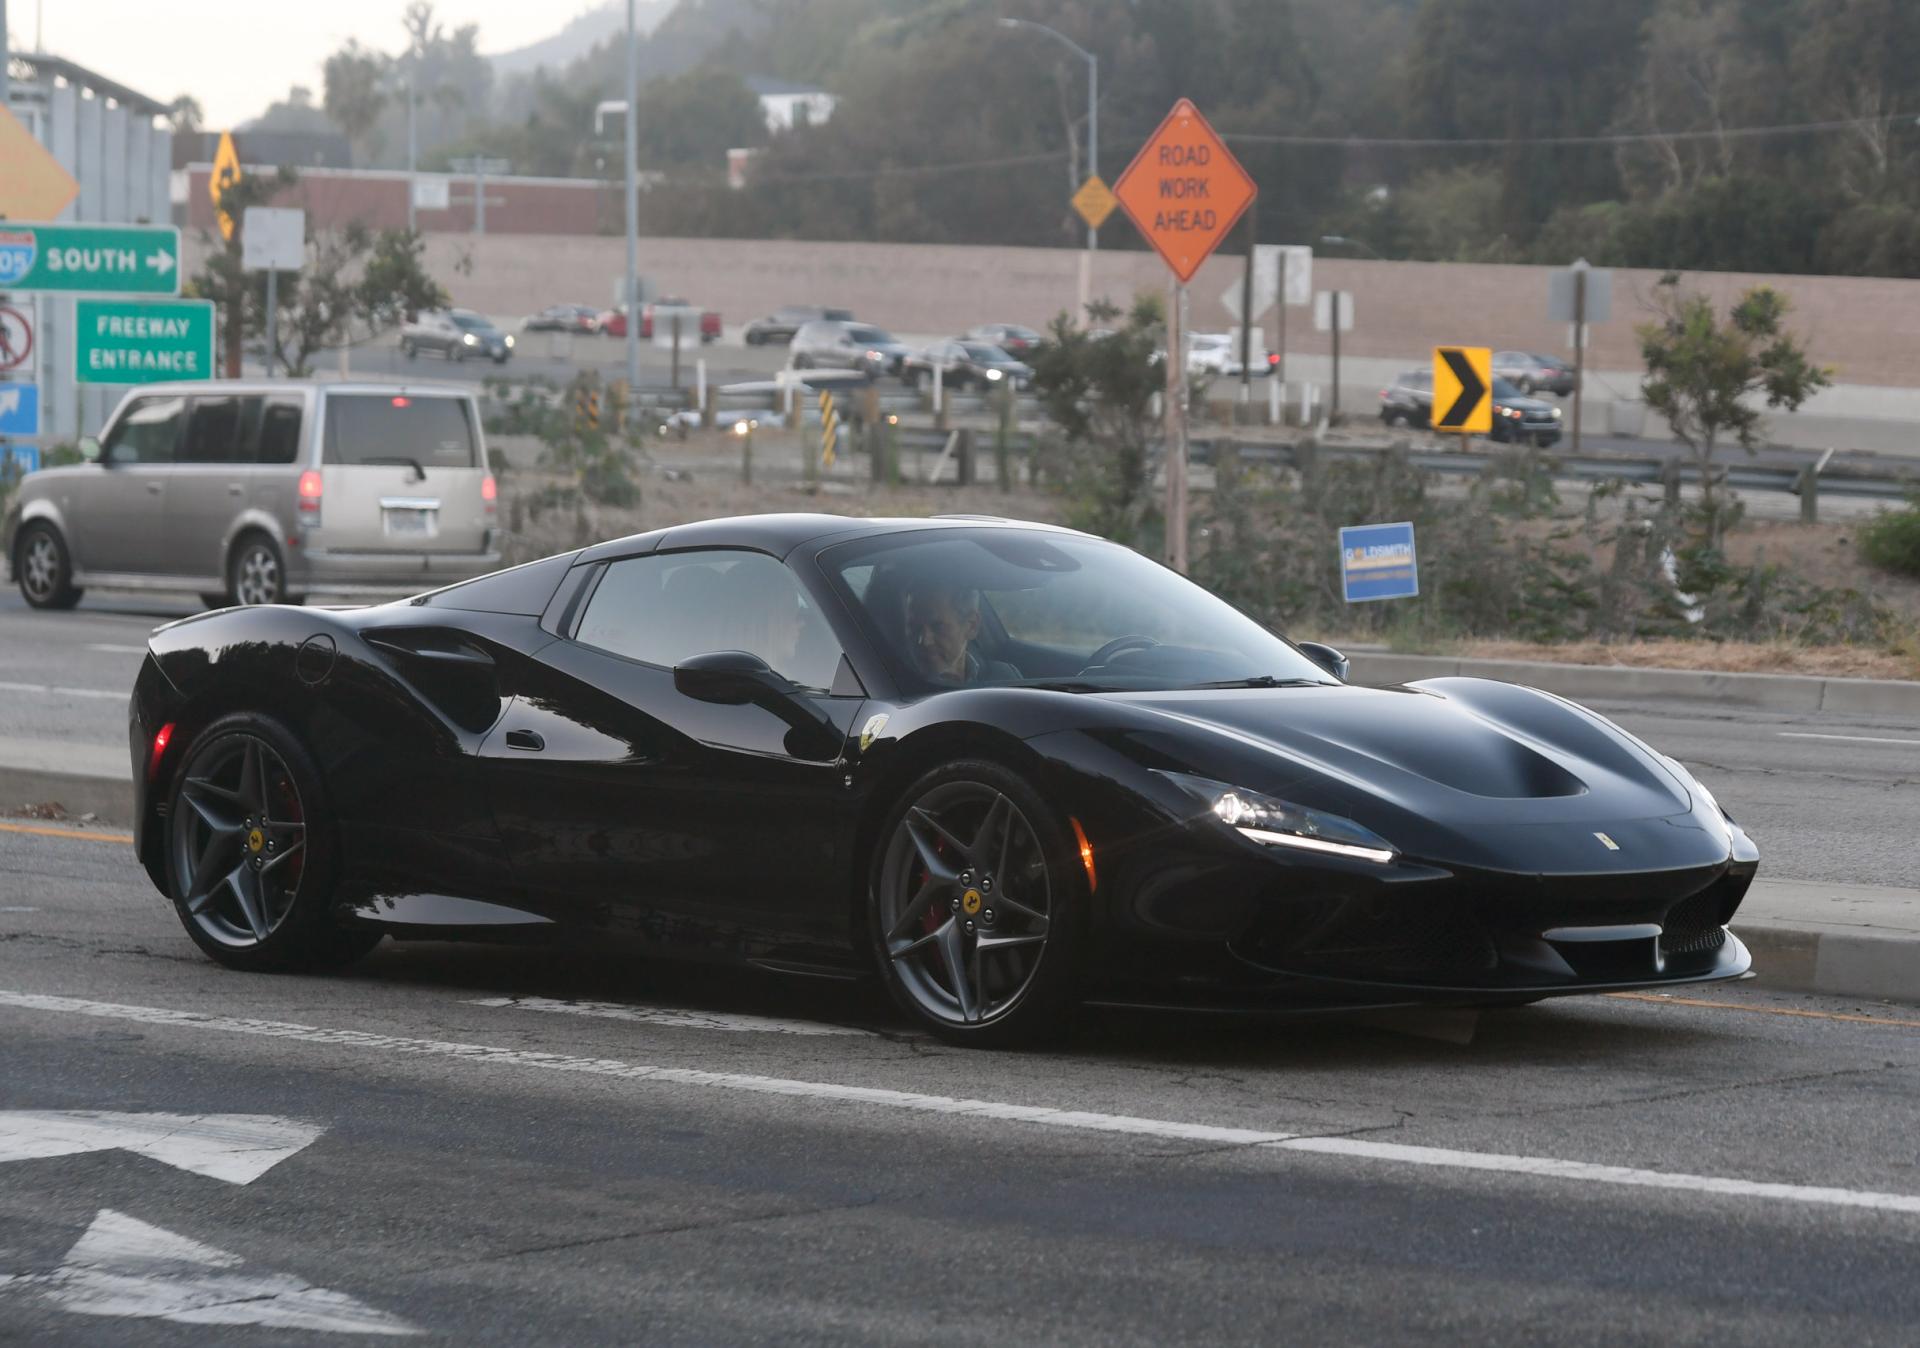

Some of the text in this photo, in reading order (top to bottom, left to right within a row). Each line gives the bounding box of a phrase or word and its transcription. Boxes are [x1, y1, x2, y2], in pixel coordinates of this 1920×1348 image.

[1159, 145, 1210, 166] ROAD
[1159, 177, 1210, 199] WORK
[1154, 209, 1217, 231] AHEAD
[46, 249, 137, 272] SOUTH
[96, 316, 190, 339] FREEWAY
[89, 349, 198, 372] ENTRANCE
